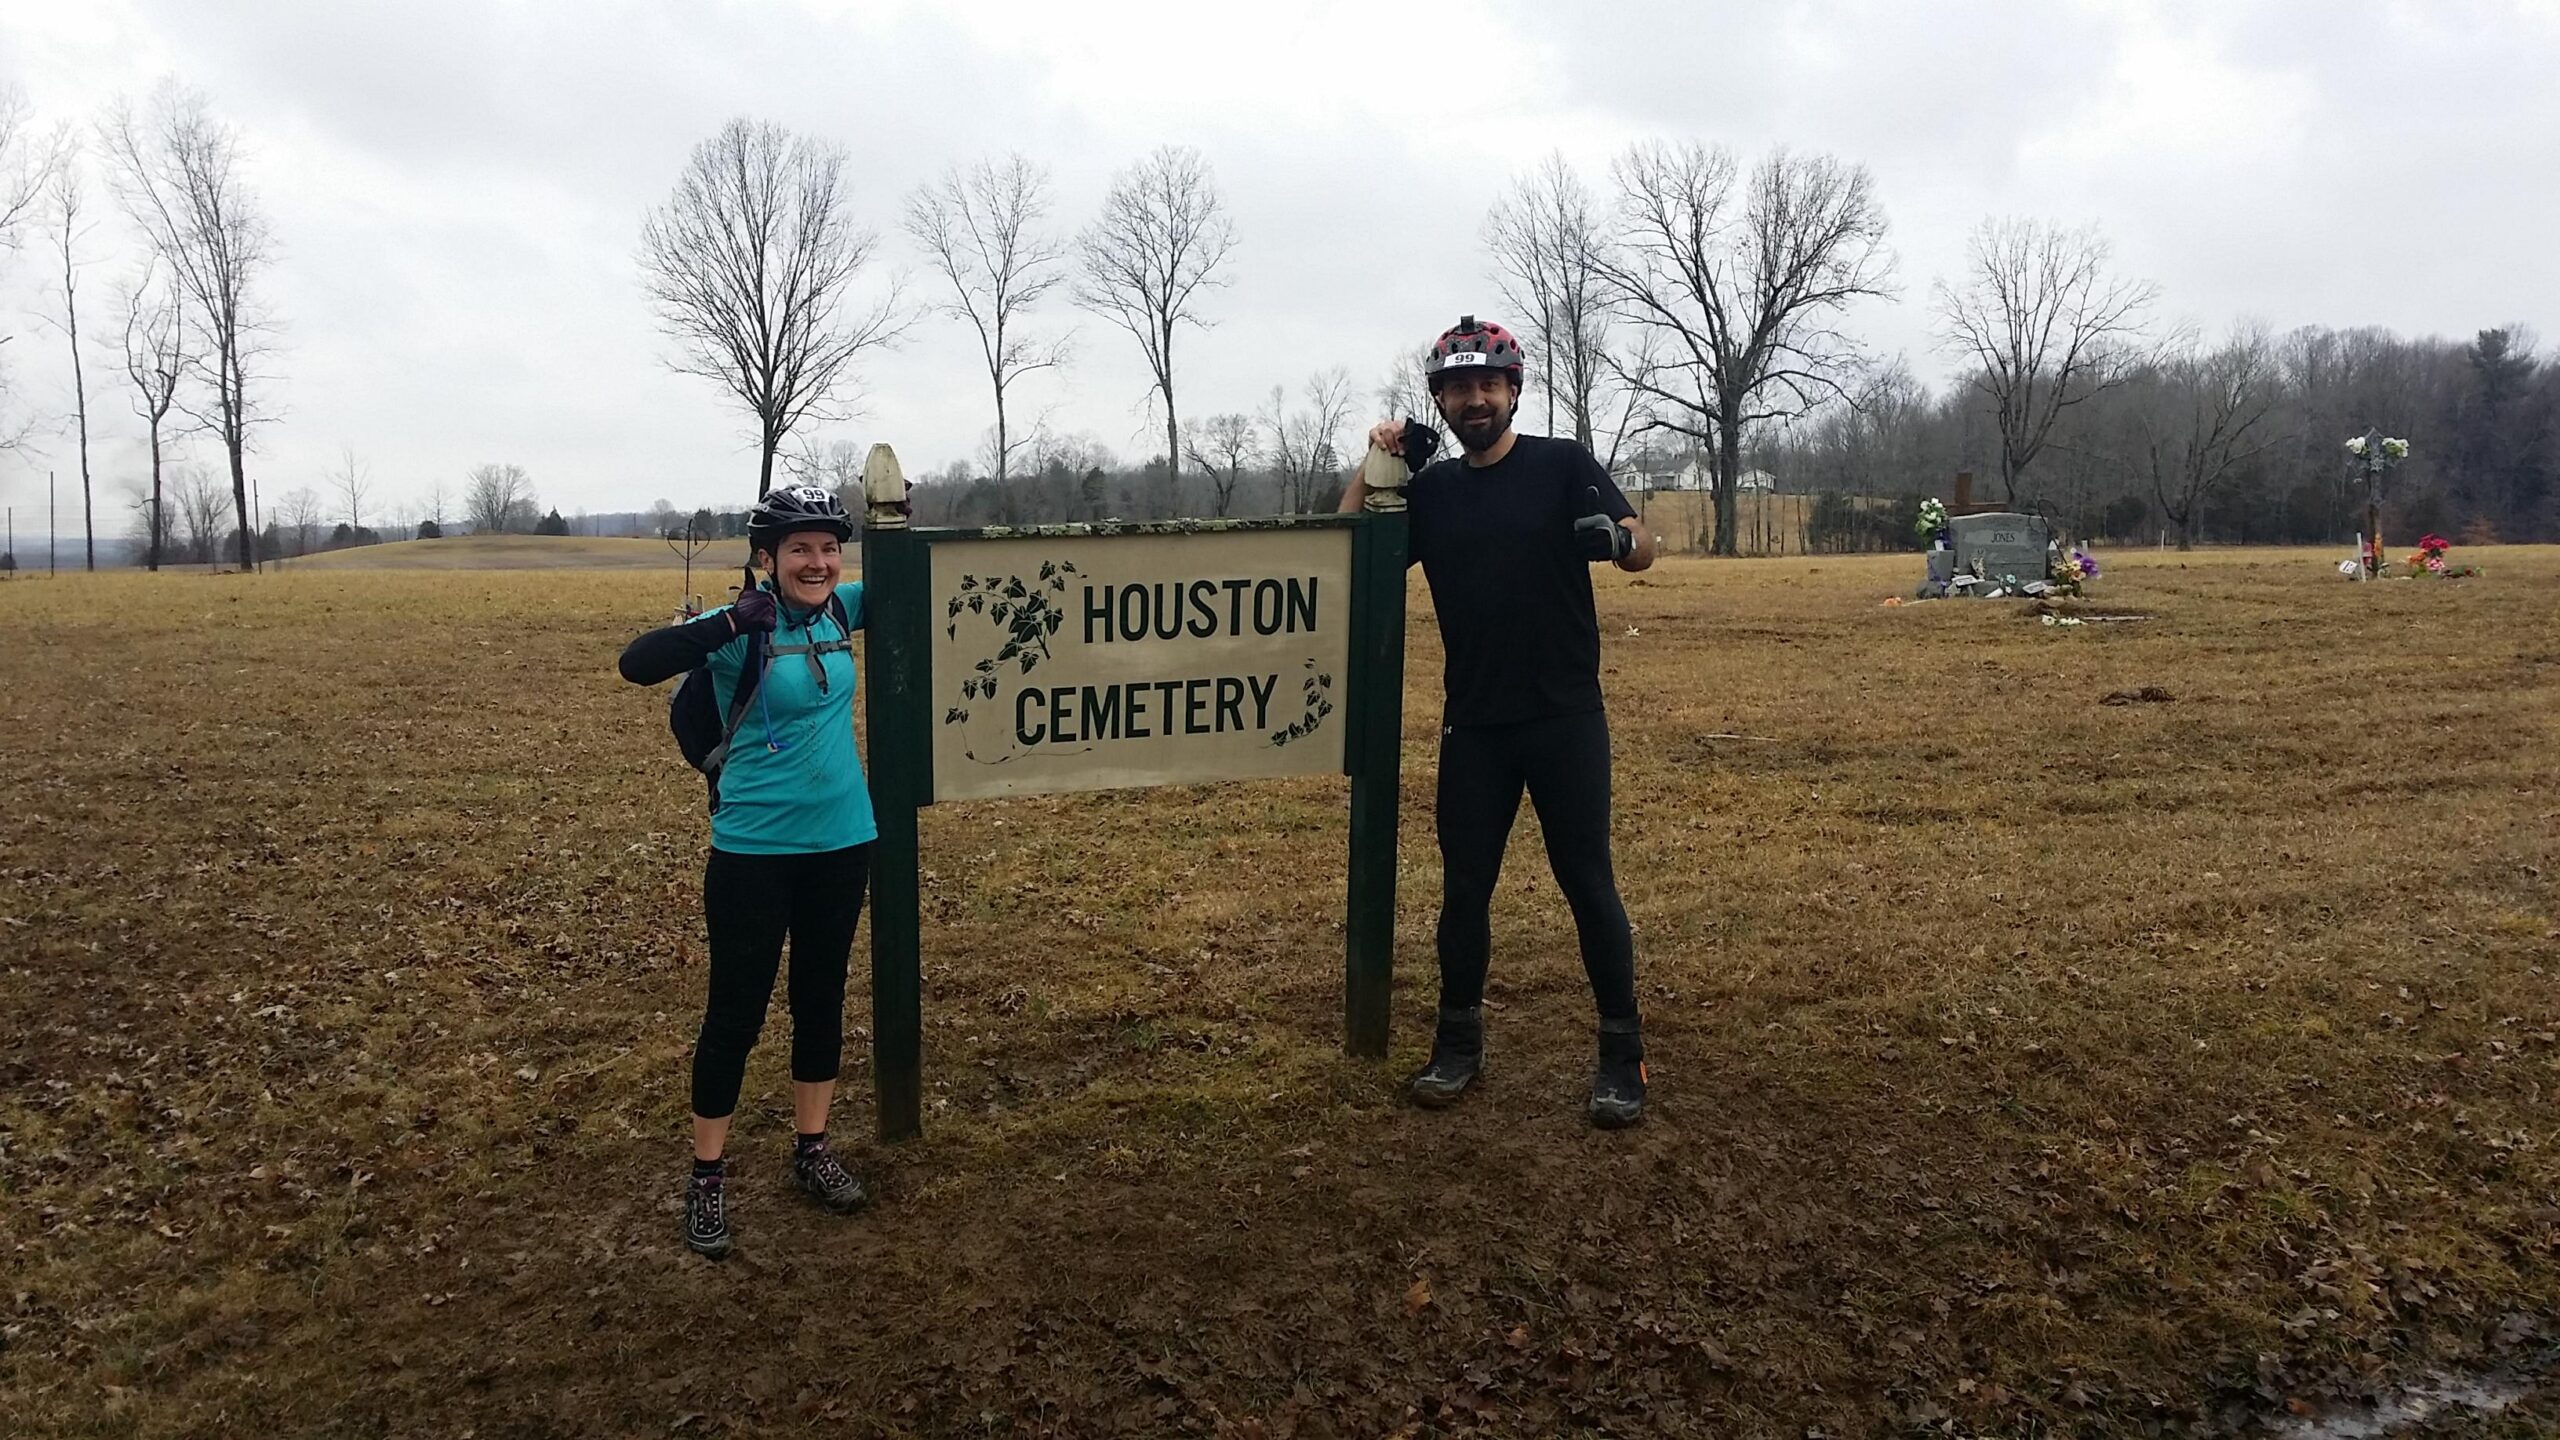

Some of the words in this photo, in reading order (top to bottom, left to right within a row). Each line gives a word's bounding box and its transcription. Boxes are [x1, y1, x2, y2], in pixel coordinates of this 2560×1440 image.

[1455, 354, 1475, 364] 99
[803, 489, 825, 500] 99
[1991, 532, 2016, 543] JONES
[1083, 576, 1319, 644] HOUSTON
[1015, 673, 1279, 746] CEMETERY
